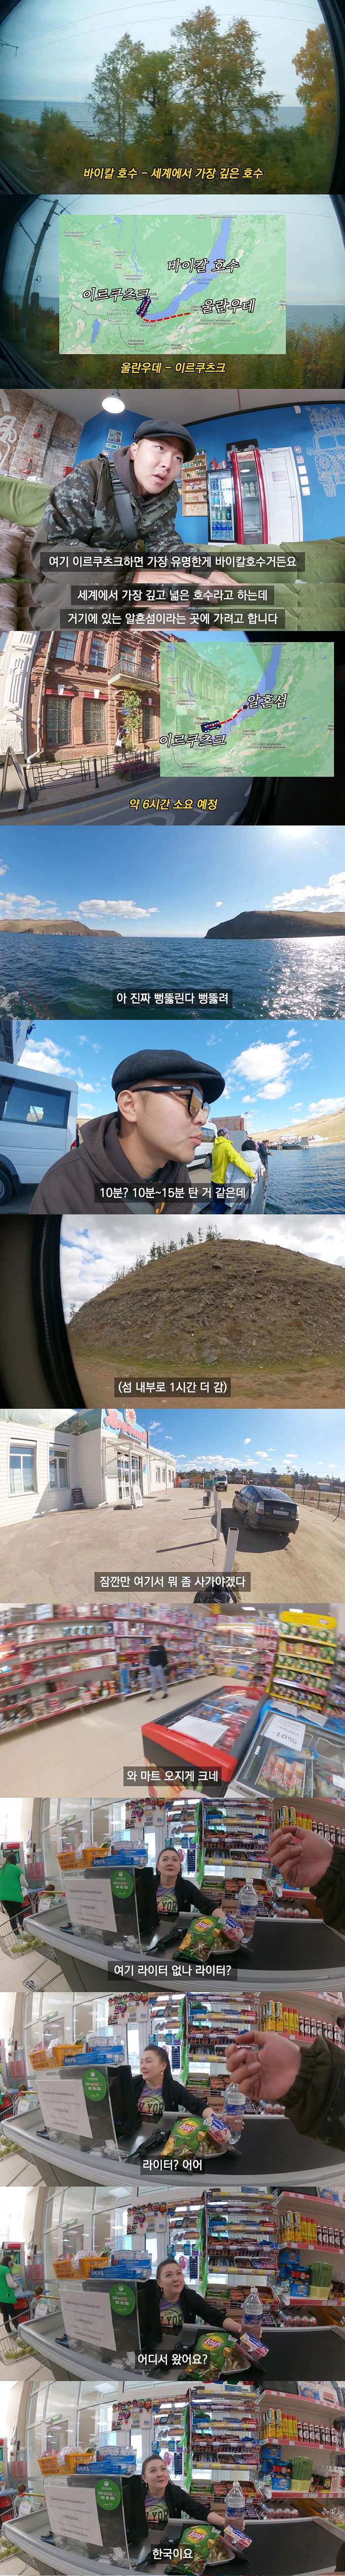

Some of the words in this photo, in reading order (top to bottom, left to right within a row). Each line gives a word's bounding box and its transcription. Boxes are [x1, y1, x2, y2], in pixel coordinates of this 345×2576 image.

[162, 1901, 178, 1912] YOR
[147, 2102, 164, 2114] YOR
[166, 2315, 182, 2326] YOR
[152, 2509, 169, 2521] YOR
